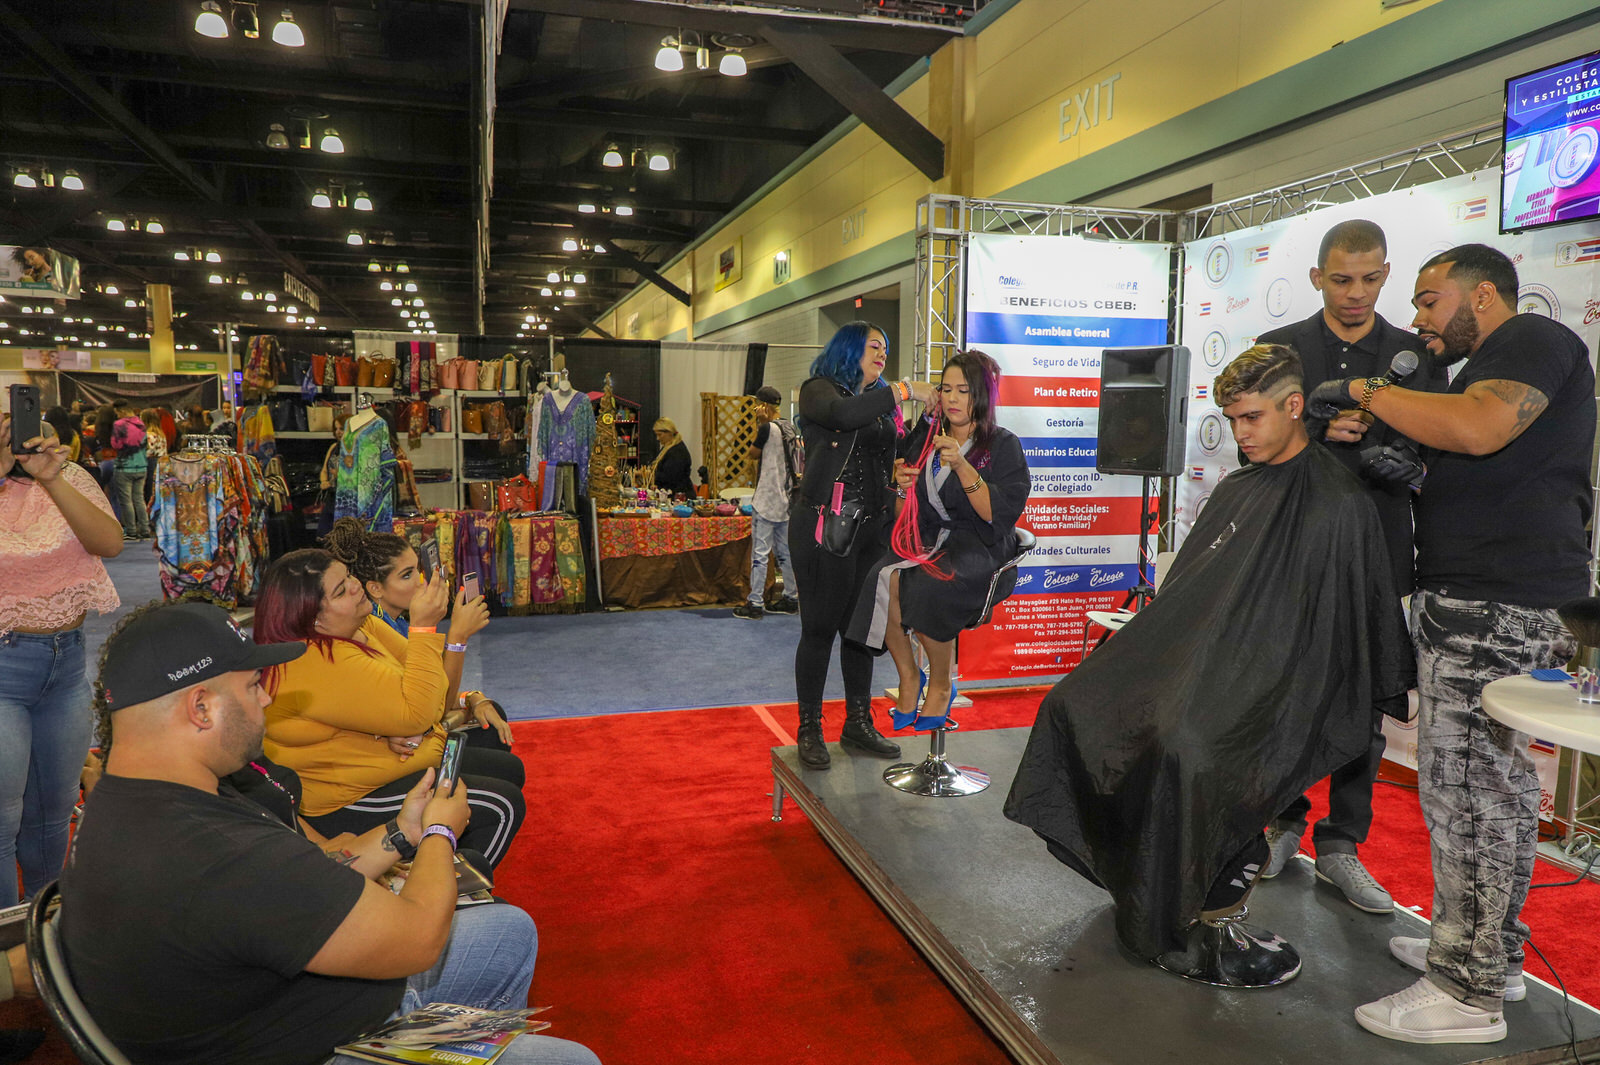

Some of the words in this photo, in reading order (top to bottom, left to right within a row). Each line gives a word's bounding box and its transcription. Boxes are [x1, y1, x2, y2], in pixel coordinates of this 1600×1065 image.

[1556, 68, 1598, 86] COLEG
[1534, 79, 1599, 103] ESTILISTA
[1058, 72, 1122, 143] EXIT
[841, 208, 868, 245] EXIT
[1000, 296, 1088, 308] BENEFICIOS
[1094, 300, 1136, 310] CBEB:
[1025, 326, 1071, 336] Asamblea
[1074, 327, 1110, 338] General
[1032, 357, 1064, 368] Seguro
[1068, 358, 1078, 367] de
[1080, 358, 1101, 367] Vida
[1034, 387, 1053, 396] Plan
[1056, 388, 1067, 397] de
[1069, 388, 1098, 397] Retiro
[1046, 417, 1084, 428] Gestoría
[1068, 447, 1098, 457] Educat
[1090, 474, 1103, 482] ID.
[1047, 483, 1092, 494] Colegiado
[1022, 504, 1067, 514] tividades
[1070, 505, 1109, 514] Sociales:
[1026, 514, 1049, 523] (Fiesta
[1028, 547, 1063, 555] vidades
[1066, 545, 1111, 555] Culturales
[1090, 568, 1102, 576] Soy
[1044, 573, 1080, 589] Colegio
[1090, 571, 1125, 587] Colegio
[430, 1051, 472, 1064] EQUIPO
